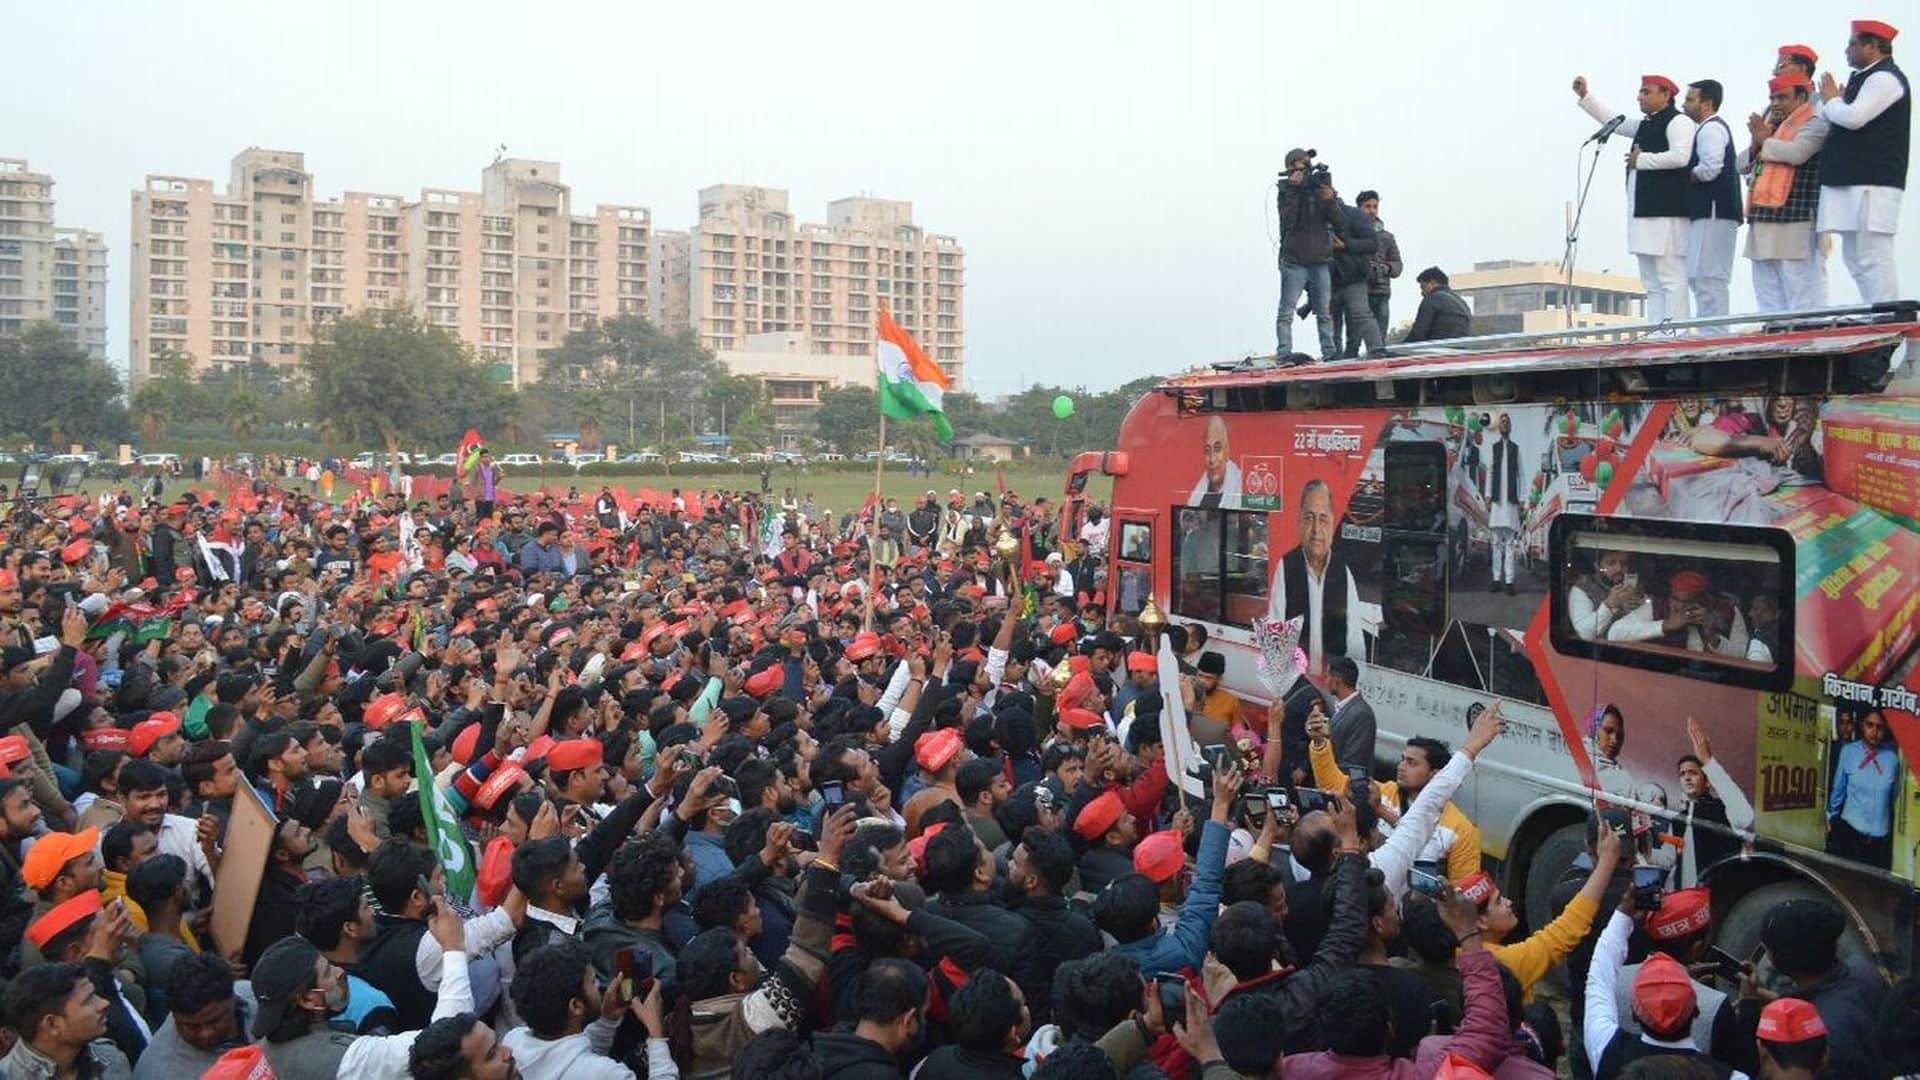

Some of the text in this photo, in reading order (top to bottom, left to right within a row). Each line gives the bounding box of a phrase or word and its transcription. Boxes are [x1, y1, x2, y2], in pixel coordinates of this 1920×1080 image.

[1294, 429, 1361, 452] 22 में बाइसिकल
[1823, 672, 1877, 707] किसान,
[1760, 764, 1818, 797] 1090
